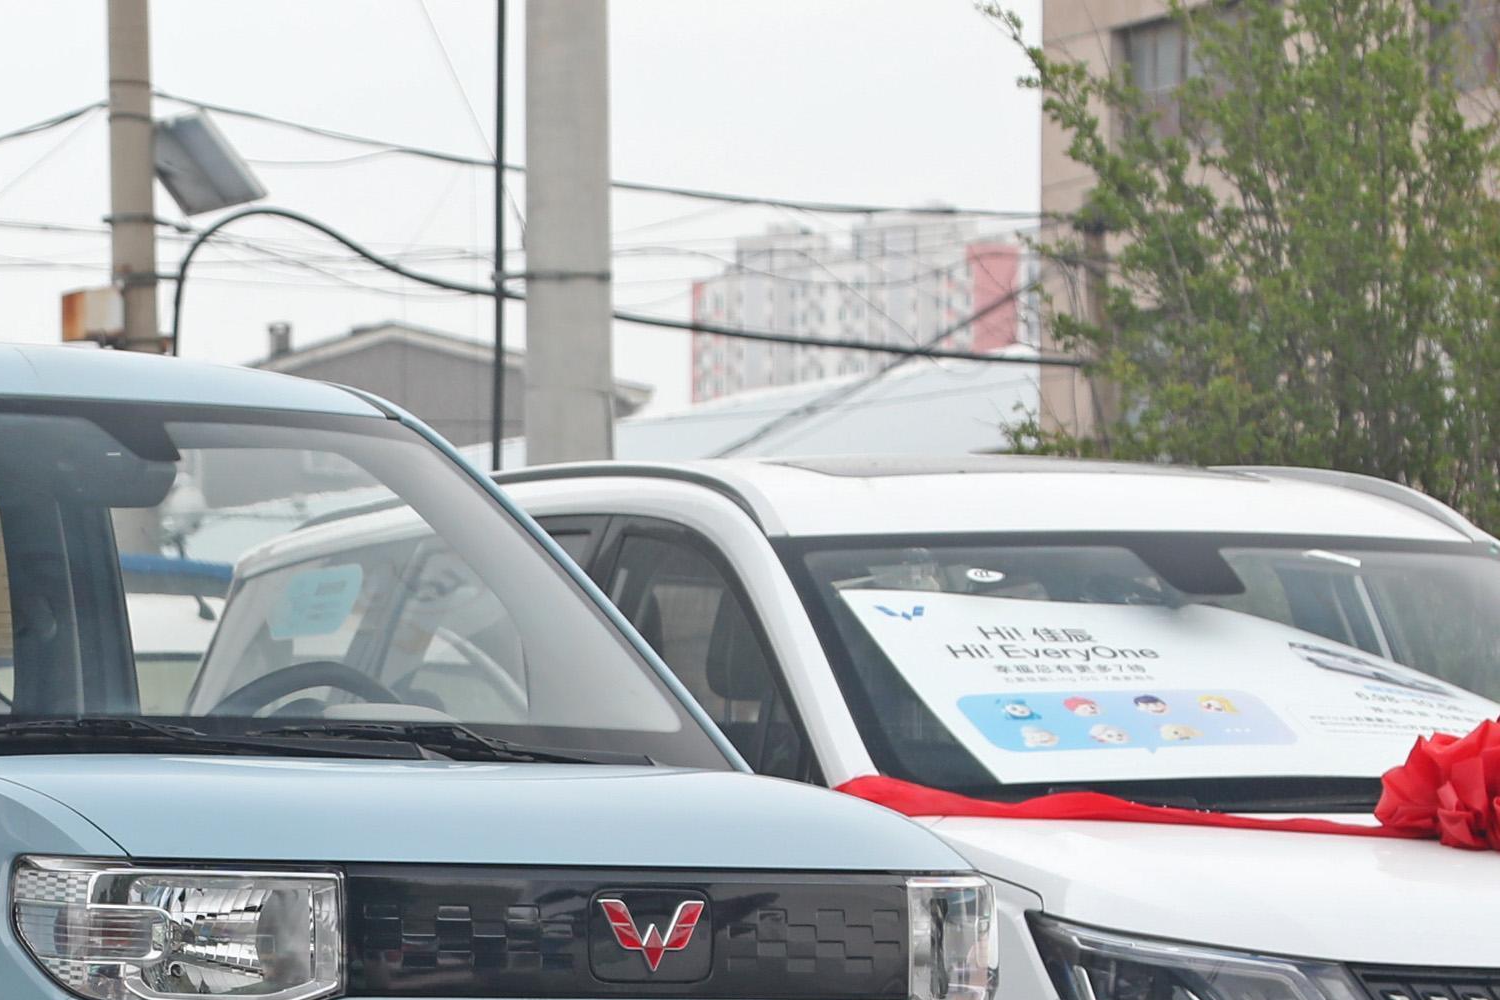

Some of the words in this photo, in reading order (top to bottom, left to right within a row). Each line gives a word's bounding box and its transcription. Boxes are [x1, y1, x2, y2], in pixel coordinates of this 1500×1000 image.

[977, 625, 1027, 641] Hi!
[1032, 627, 1097, 643] 佳辰
[946, 644, 994, 659] Hi!
[998, 644, 1160, 662] EveryOne
